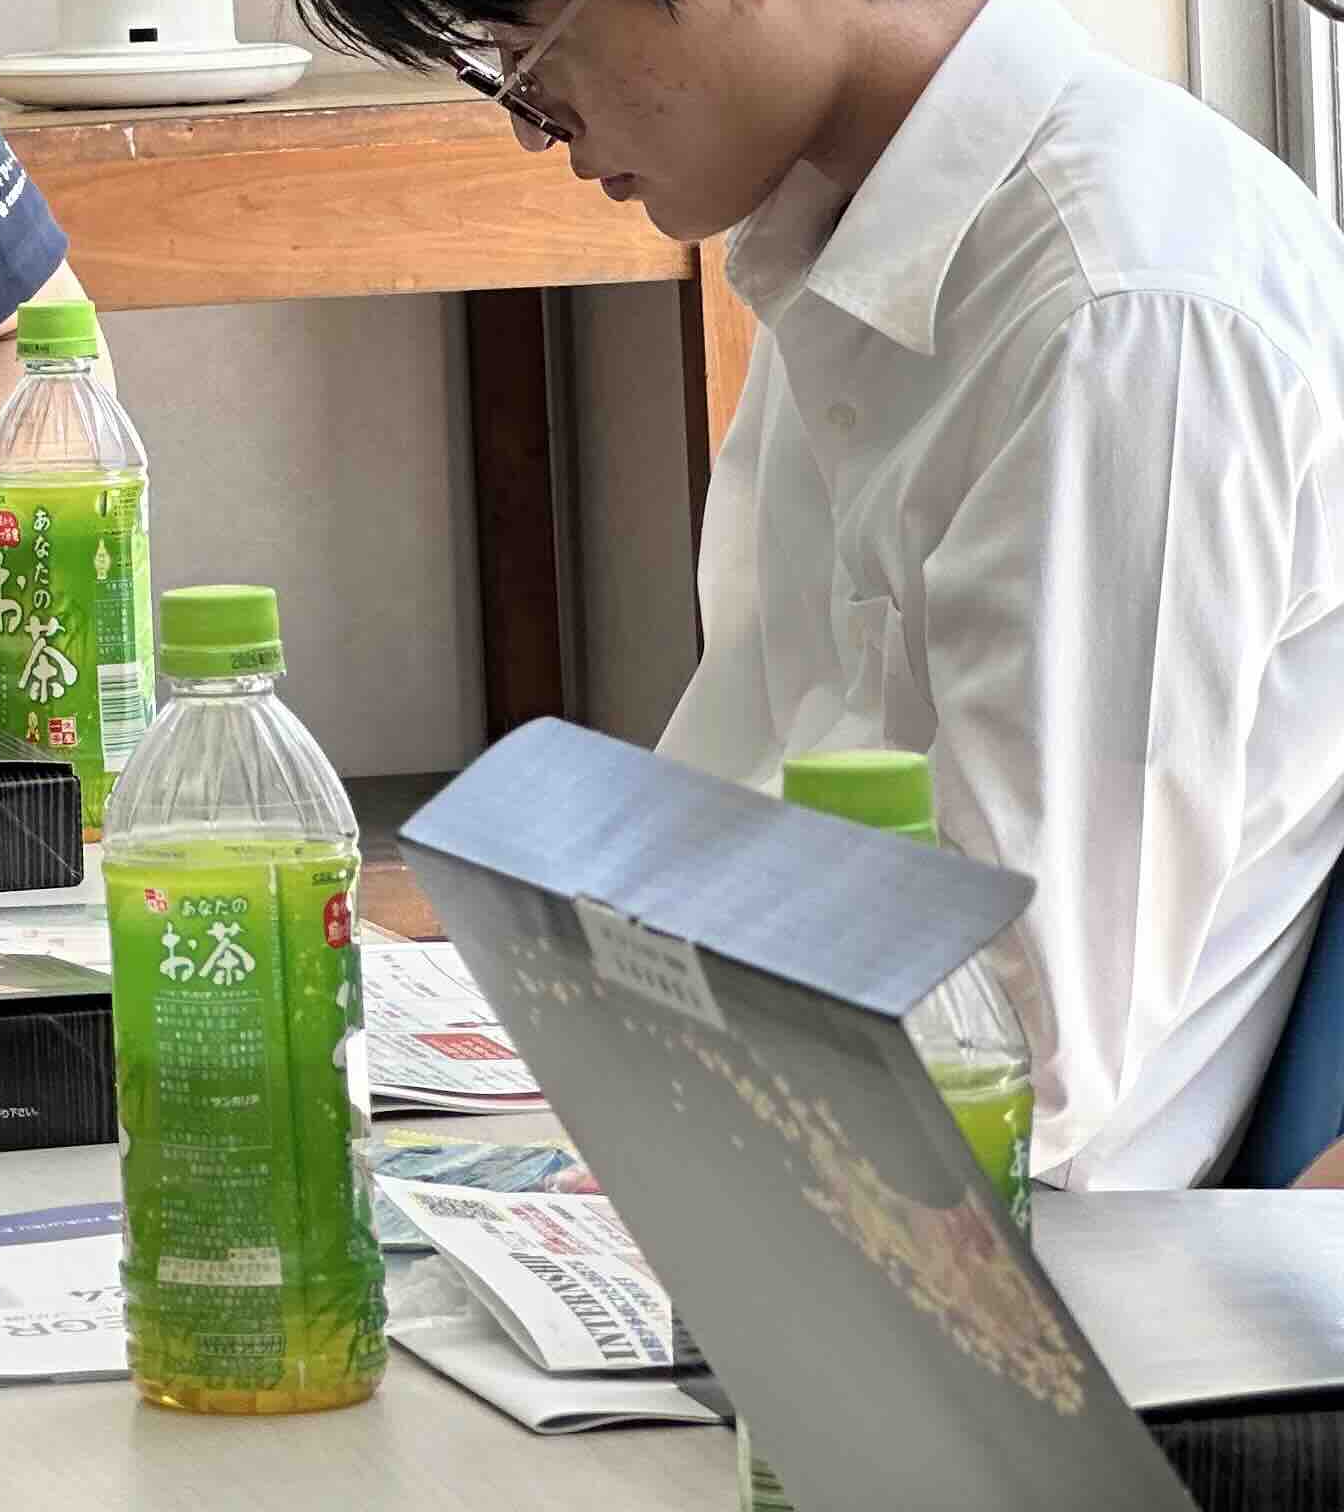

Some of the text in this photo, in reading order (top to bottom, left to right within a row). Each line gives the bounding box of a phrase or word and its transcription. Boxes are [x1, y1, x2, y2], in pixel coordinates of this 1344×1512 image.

[33, 509, 51, 609] あなたの
[159, 920, 257, 986] お茶
